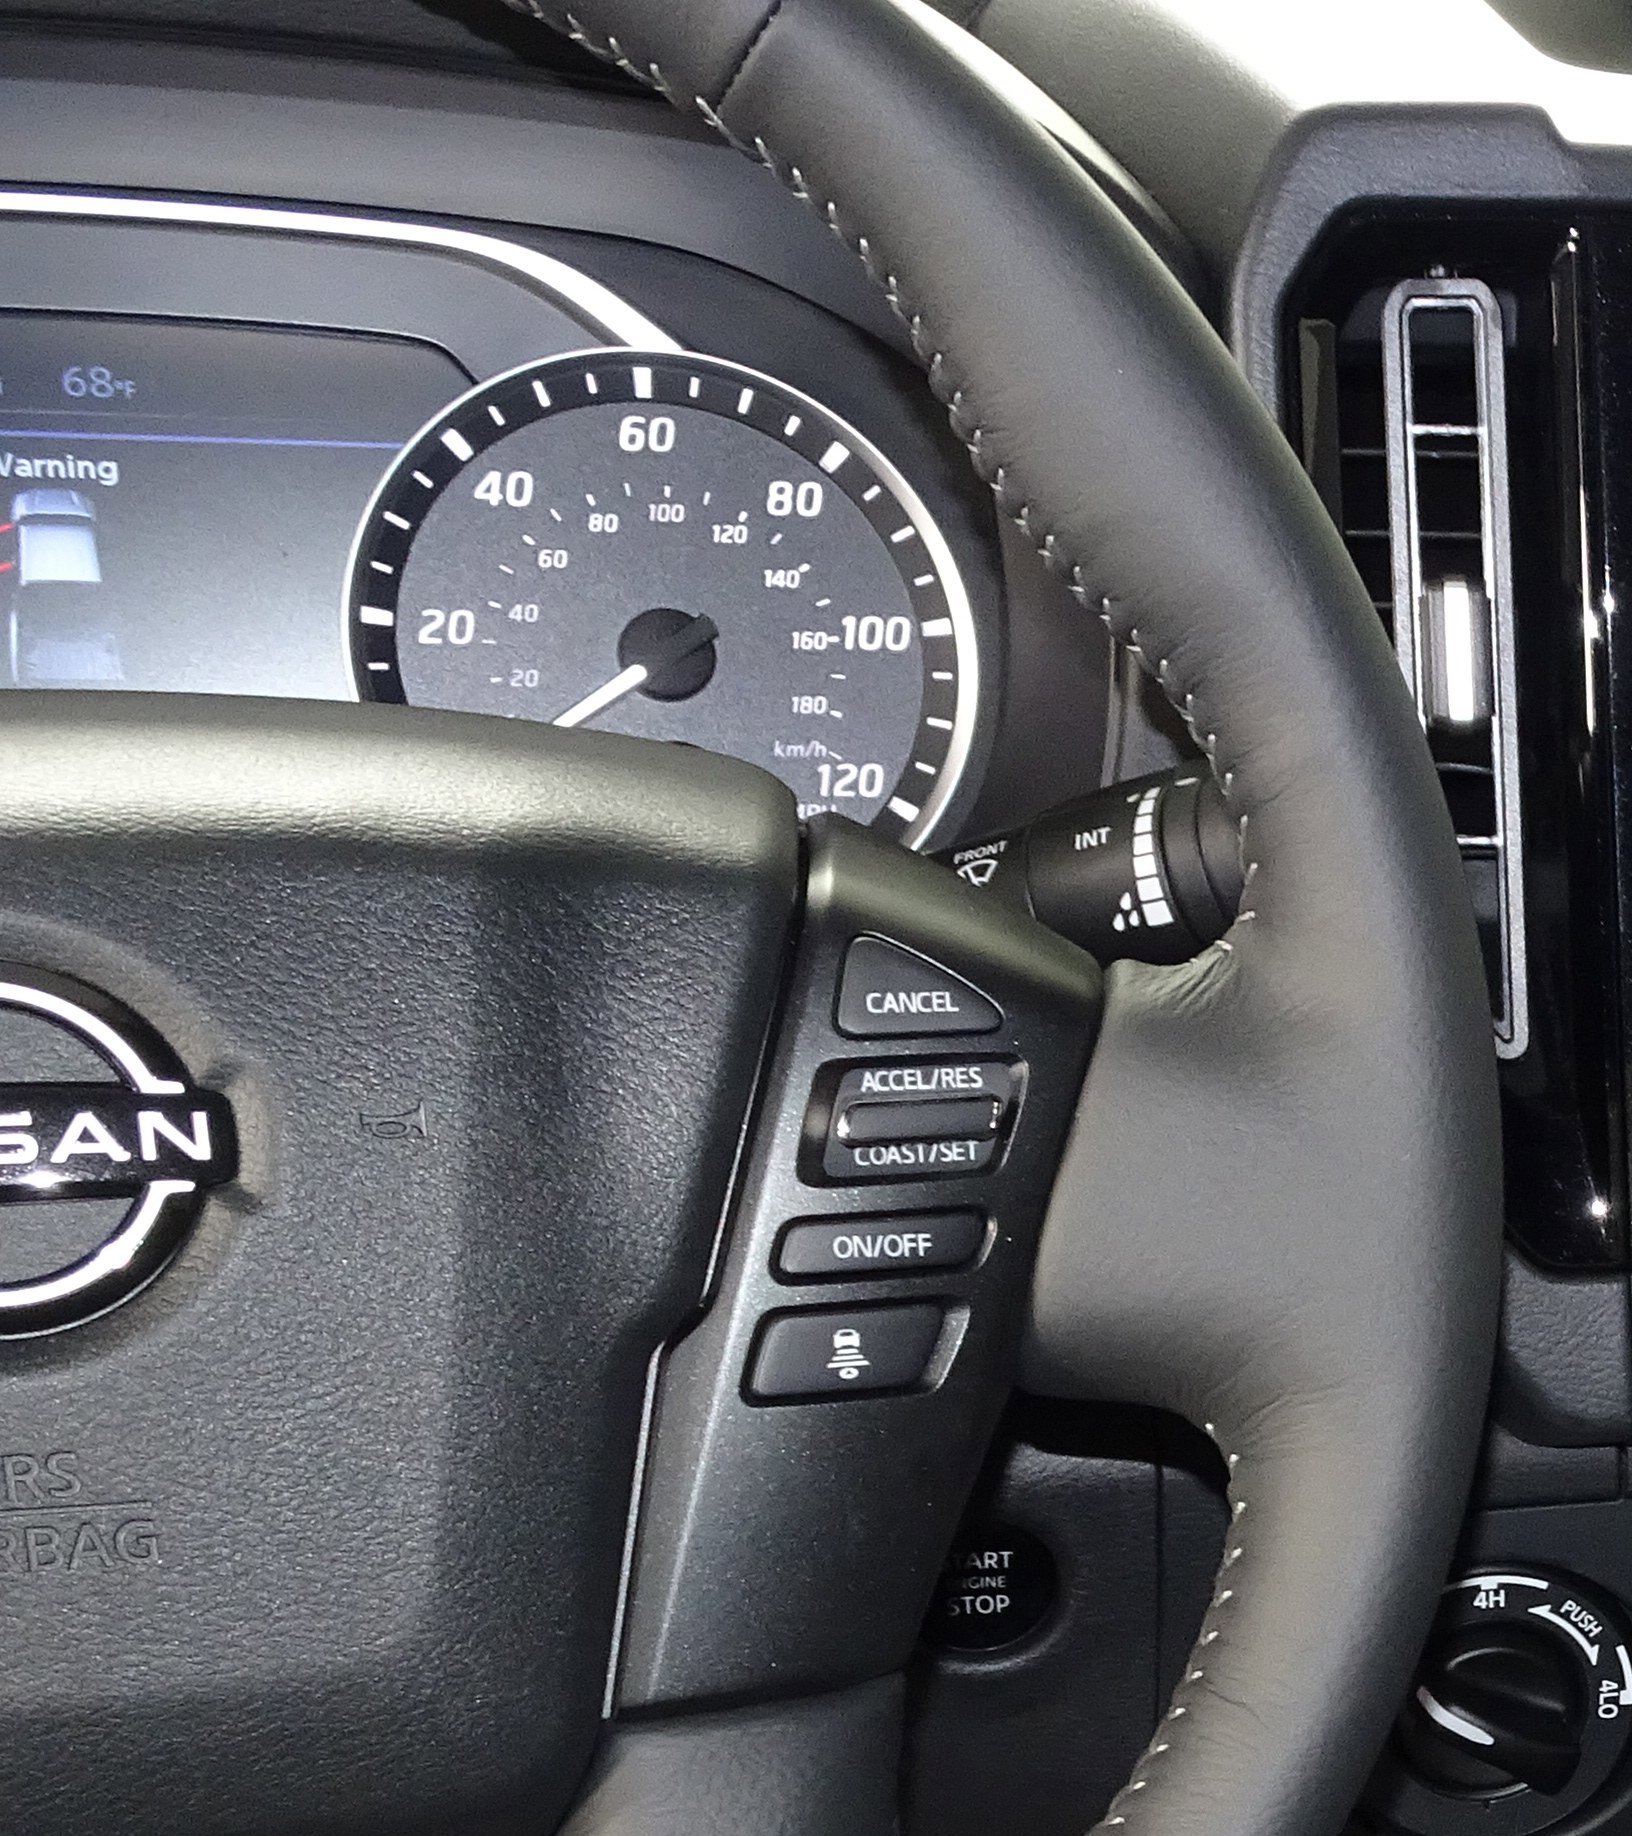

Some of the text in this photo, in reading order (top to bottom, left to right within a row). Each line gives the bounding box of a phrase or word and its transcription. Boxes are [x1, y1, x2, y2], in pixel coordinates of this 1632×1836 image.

[619, 415, 676, 452] 60
[474, 471, 533, 507] 40
[767, 481, 823, 517] 80
[588, 514, 619, 533] 80
[649, 504, 685, 523] 100
[712, 525, 748, 543] 120
[538, 550, 568, 568] 60
[764, 570, 800, 589] 140
[508, 604, 538, 623] 40
[418, 609, 475, 645] 20
[842, 616, 911, 651] 100
[792, 631, 827, 650] 160
[510, 669, 539, 687] 20
[792, 696, 828, 714] 180
[773, 740, 827, 758] km/h
[817, 763, 884, 797] 120
[1074, 826, 1111, 850] INT
[953, 840, 1008, 864] FRONT
[865, 990, 959, 1016] CANCEL
[860, 1066, 983, 1092] ACCEL/RES
[854, 1140, 980, 1166] COAST/SET
[832, 1233, 933, 1260] ON/OFF
[1473, 1589, 1506, 1609] 4H
[1559, 1600, 1603, 1638] PUSH
[1598, 1680, 1619, 1719] 4LO
